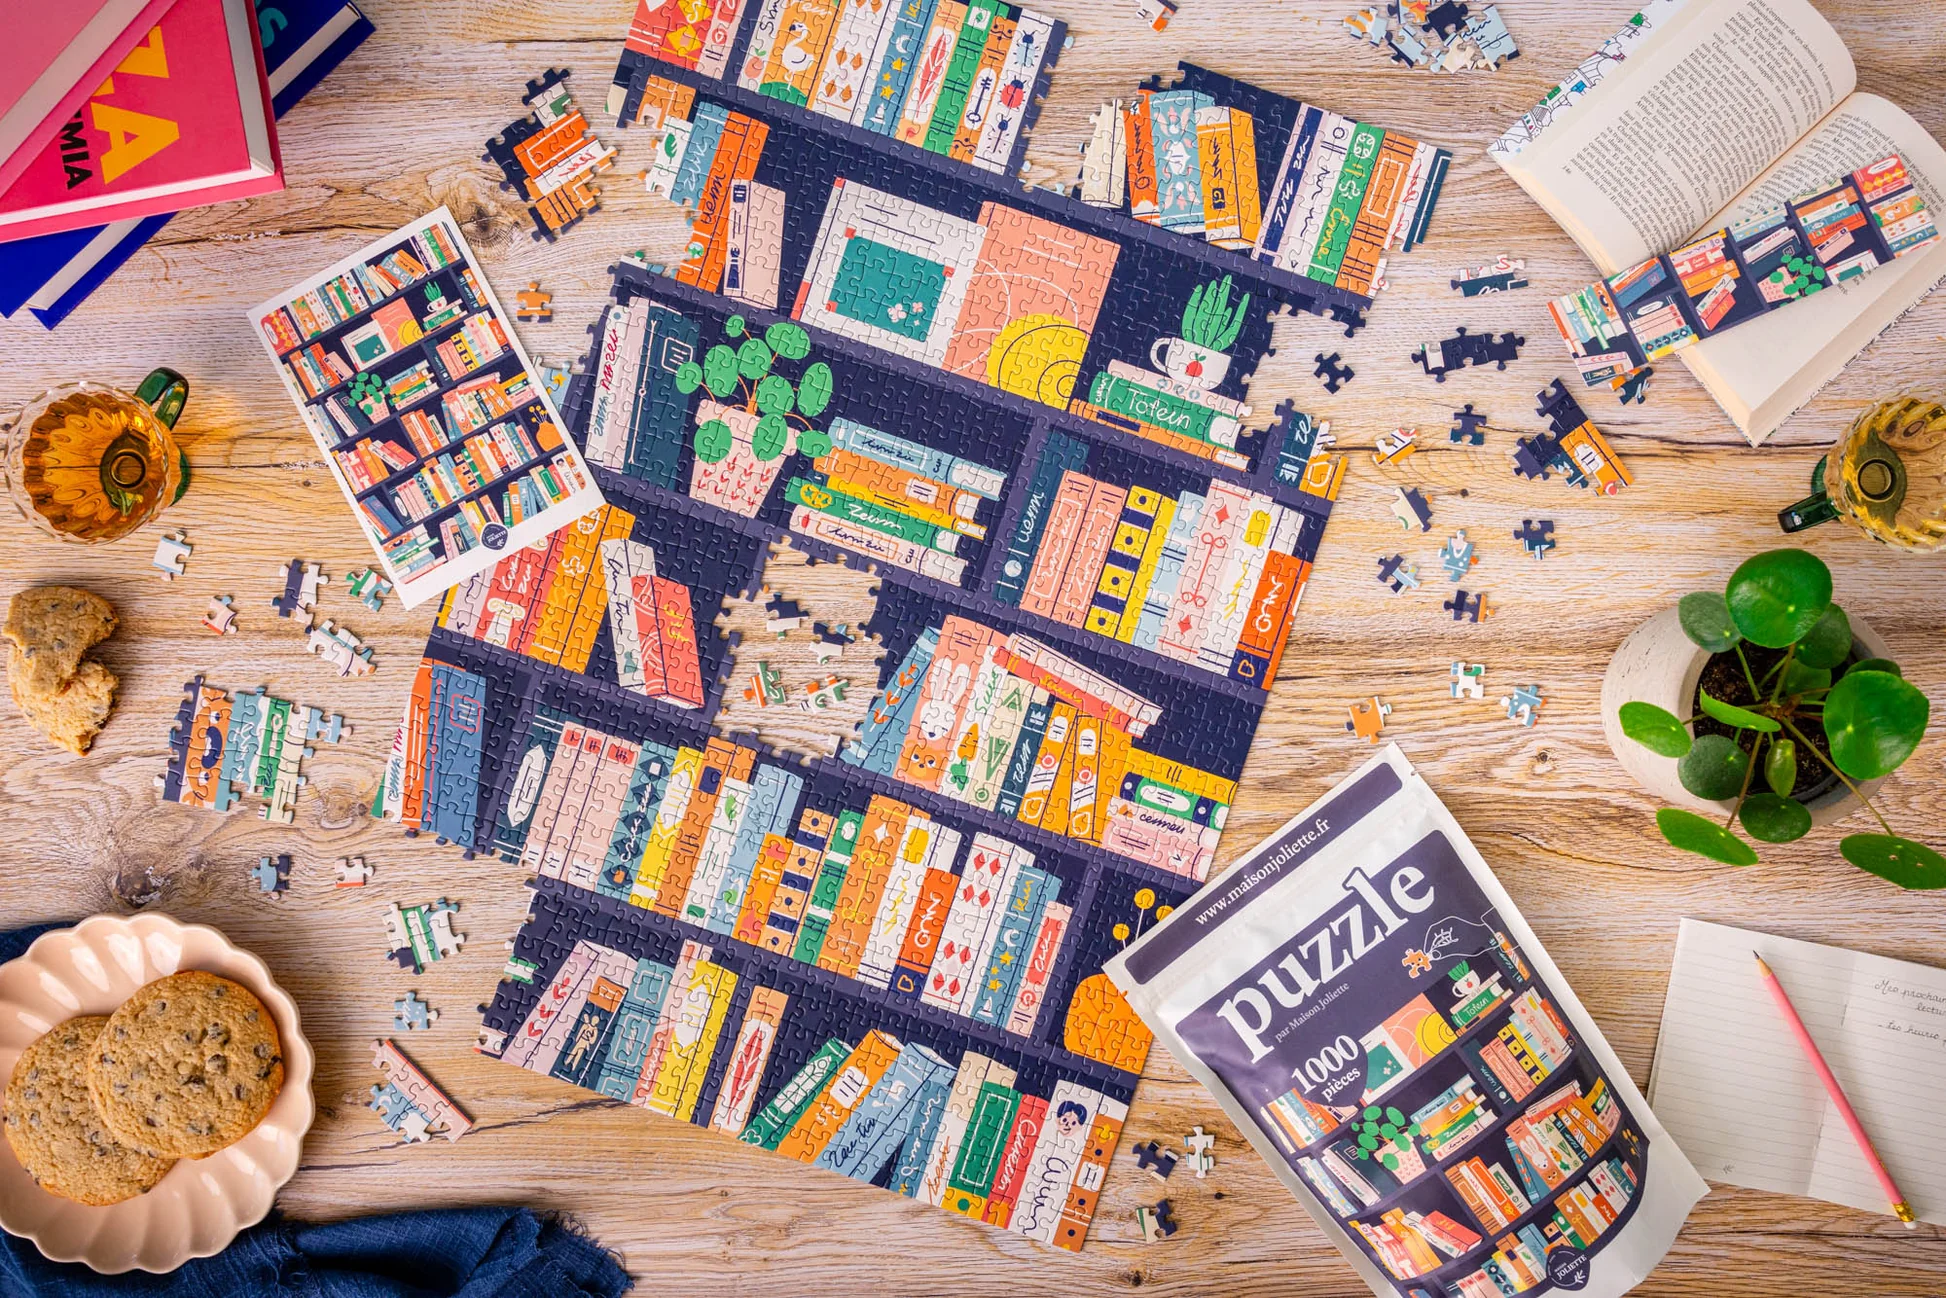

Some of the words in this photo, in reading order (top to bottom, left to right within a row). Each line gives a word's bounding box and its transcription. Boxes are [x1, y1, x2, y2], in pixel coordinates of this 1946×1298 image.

[60, 109, 93, 190] MIA
[1195, 818, 1330, 925] www.maisonjoliette.fr
[1216, 866, 1434, 1062] puzzle
[1275, 1028, 1290, 1043] par
[1288, 1004, 1321, 1031] Maison
[1318, 982, 1350, 1010] Joliette
[1291, 1035, 1359, 1094] 1000
[1321, 1067, 1361, 1102] pièces
[1557, 1254, 1587, 1280] JOLIETTE
